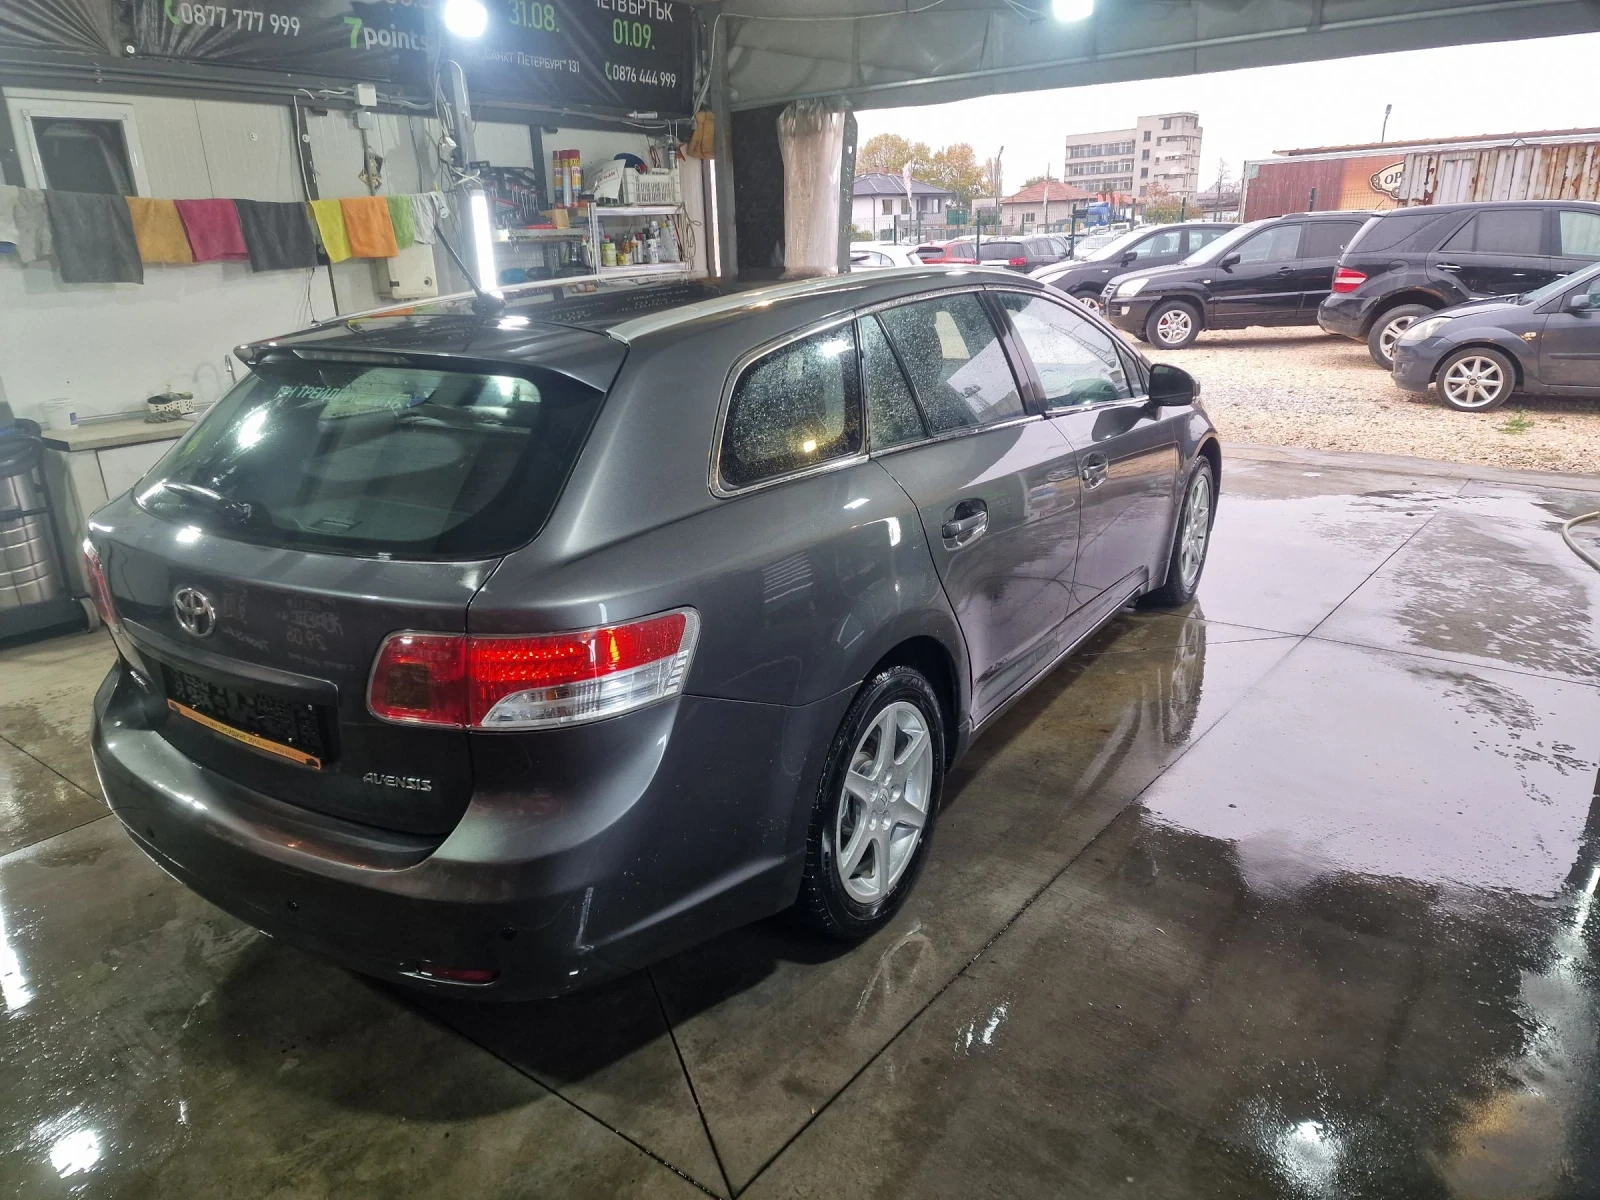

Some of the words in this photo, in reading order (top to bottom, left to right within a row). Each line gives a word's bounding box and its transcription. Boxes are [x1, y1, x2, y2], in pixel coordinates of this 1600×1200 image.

[180, 2, 227, 28] 0877
[232, 8, 264, 33] 777
[269, 13, 300, 37] 999
[612, 17, 656, 50] 01.09.
[568, 59, 580, 73] 131
[612, 63, 637, 83] 0876
[638, 68, 658, 86] 444
[660, 71, 676, 88] 999
[362, 771, 432, 792] AVENSIS
